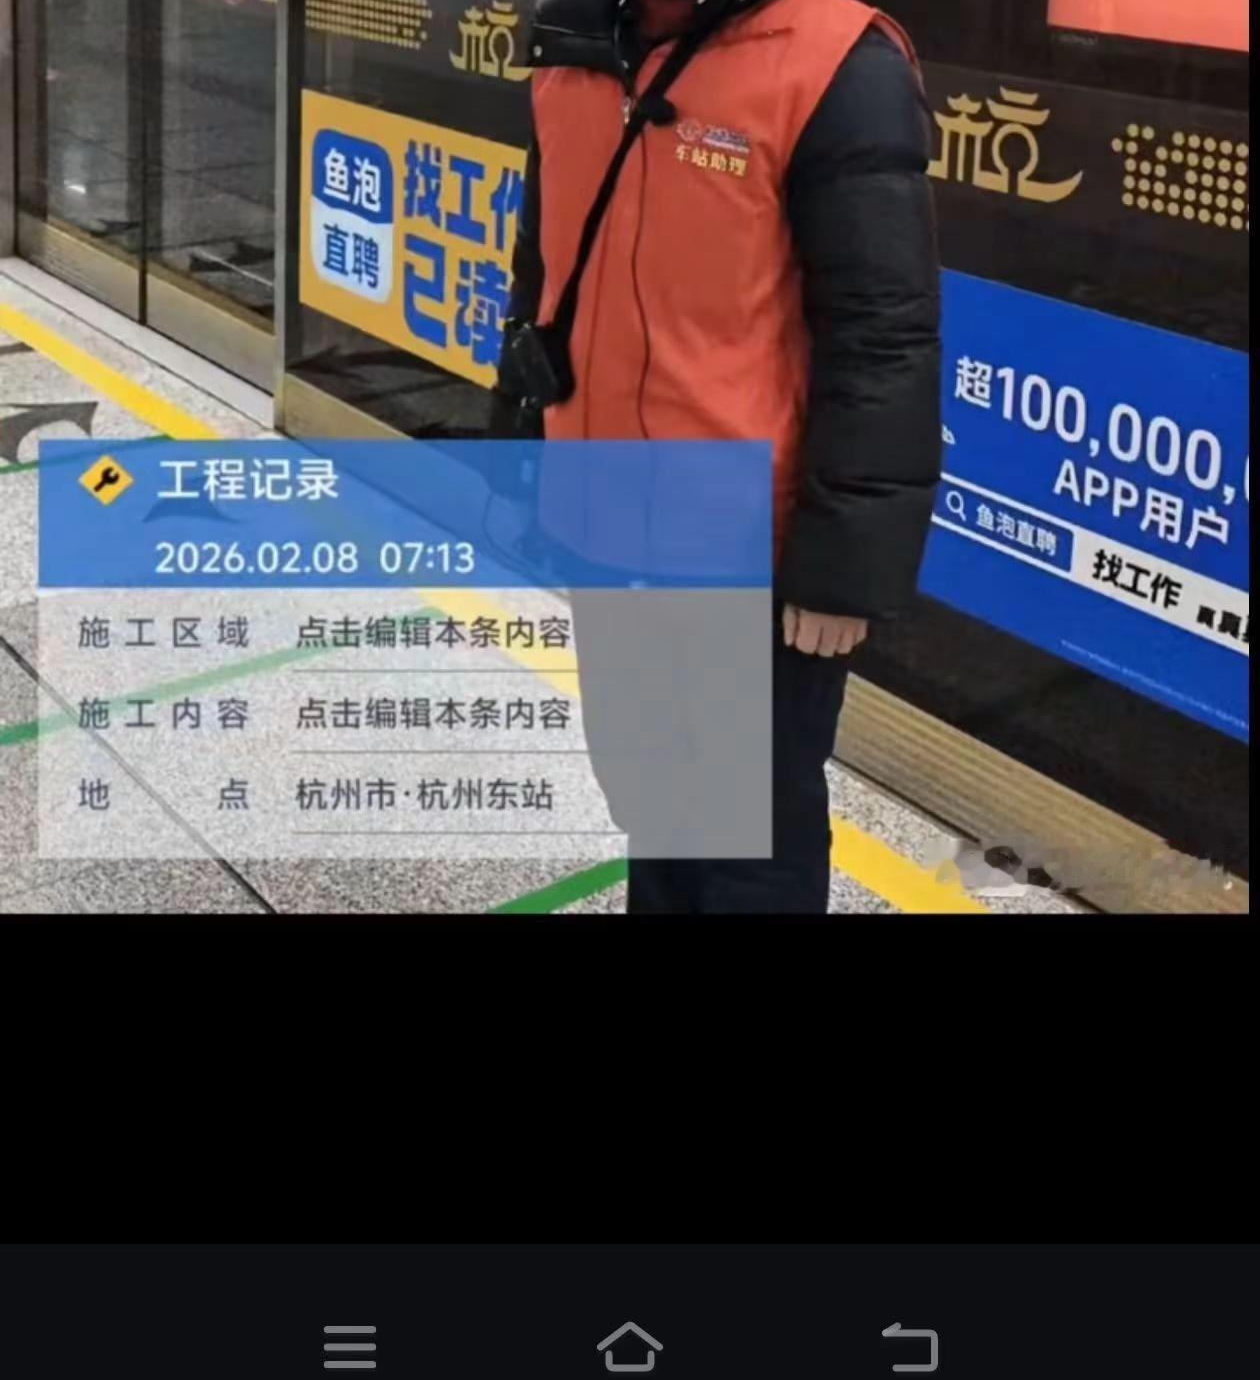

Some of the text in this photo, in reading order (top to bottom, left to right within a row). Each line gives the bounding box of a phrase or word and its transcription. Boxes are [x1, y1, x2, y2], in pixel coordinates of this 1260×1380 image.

[323, 148, 382, 213] 鱼泡
[322, 222, 380, 290] 直聘
[955, 355, 1249, 506] 超100,000,
[975, 503, 1058, 557] 鱼泡直聘
[1053, 458, 1230, 549] APP用户
[1092, 549, 1183, 609] 找工作
